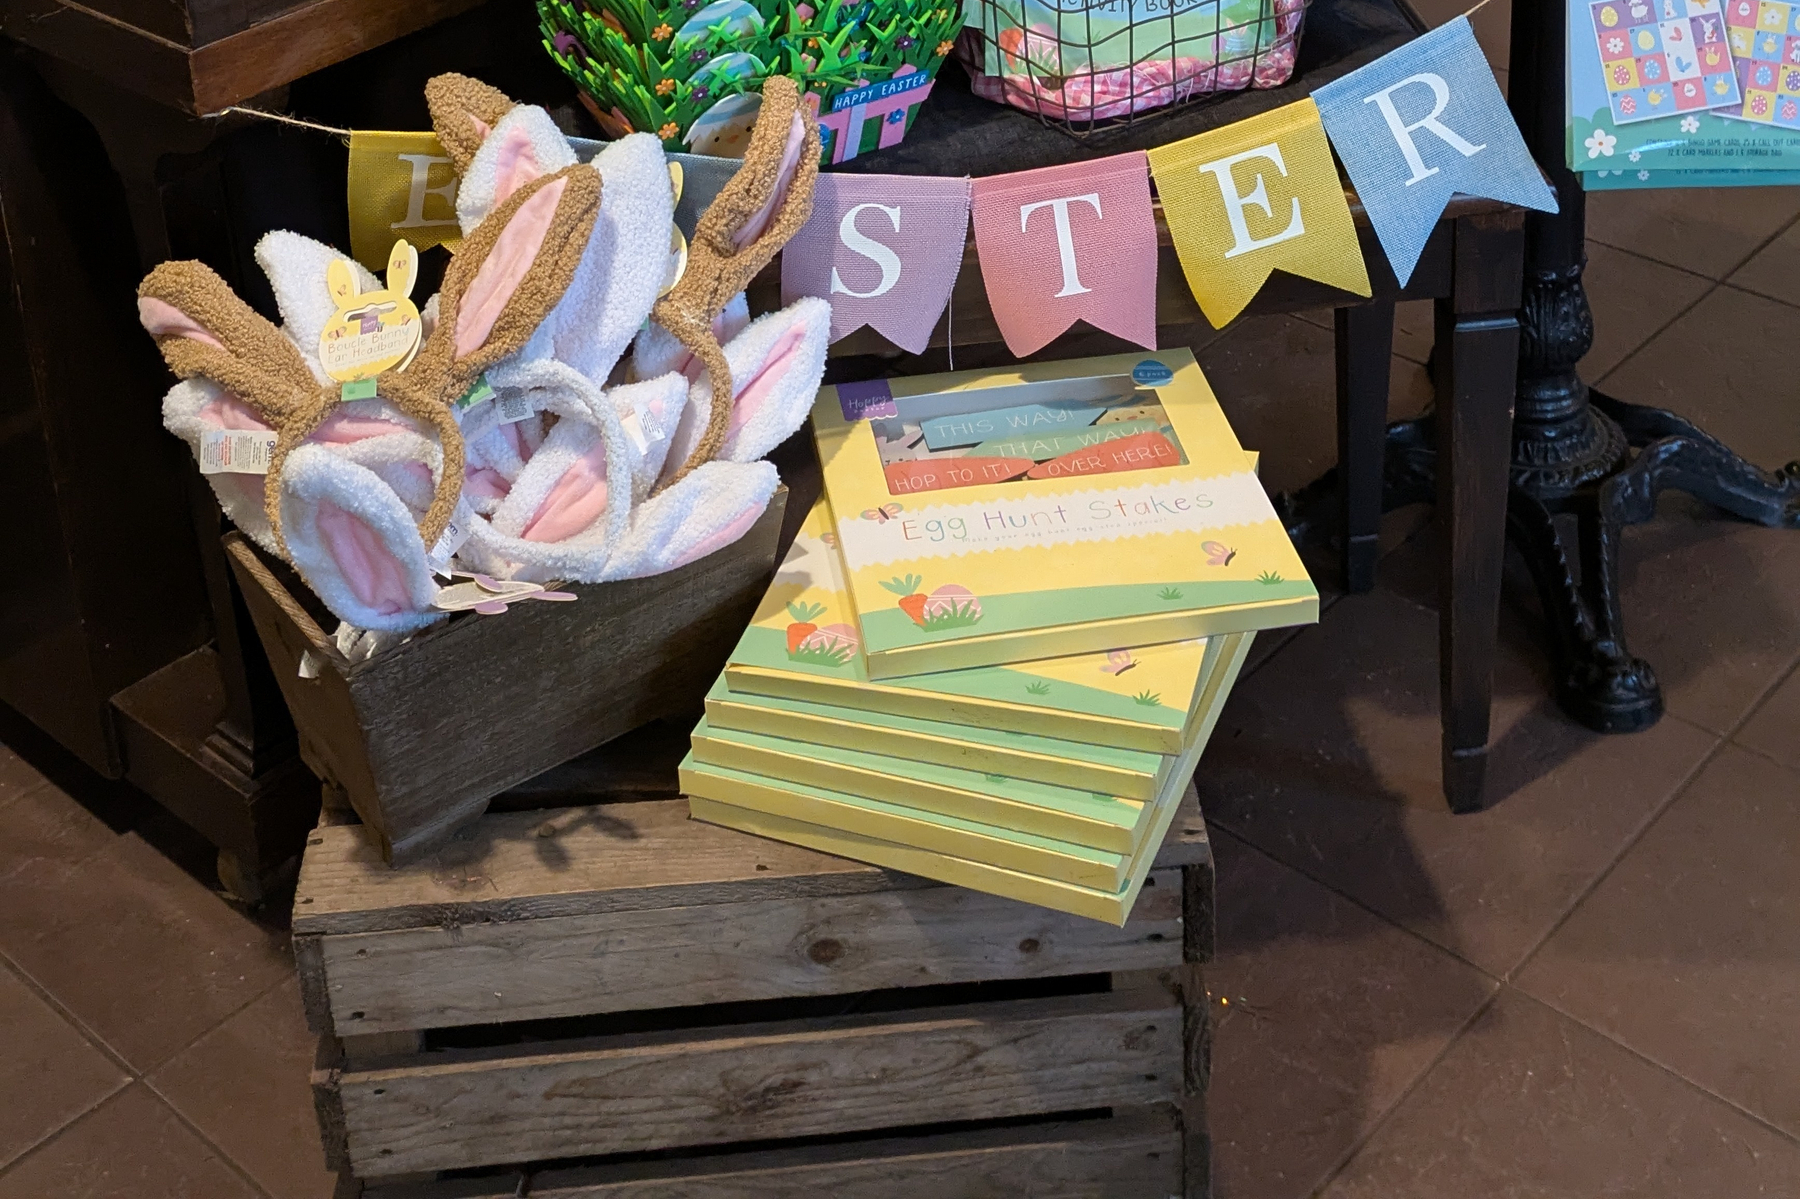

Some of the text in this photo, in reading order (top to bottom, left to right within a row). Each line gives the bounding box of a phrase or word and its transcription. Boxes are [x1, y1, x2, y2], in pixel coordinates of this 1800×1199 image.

[835, 74, 927, 110] HAPPY EASTER
[327, 328, 410, 354] Boucle Bunny
[352, 337, 409, 358] Headband
[849, 396, 887, 409] Hoppy
[934, 409, 1075, 439] THIS WAY!
[1047, 445, 1174, 477] OVER HERE!
[895, 463, 1011, 491] HOP TO IT!
[902, 491, 1214, 542] Egg Hunt Stakes
